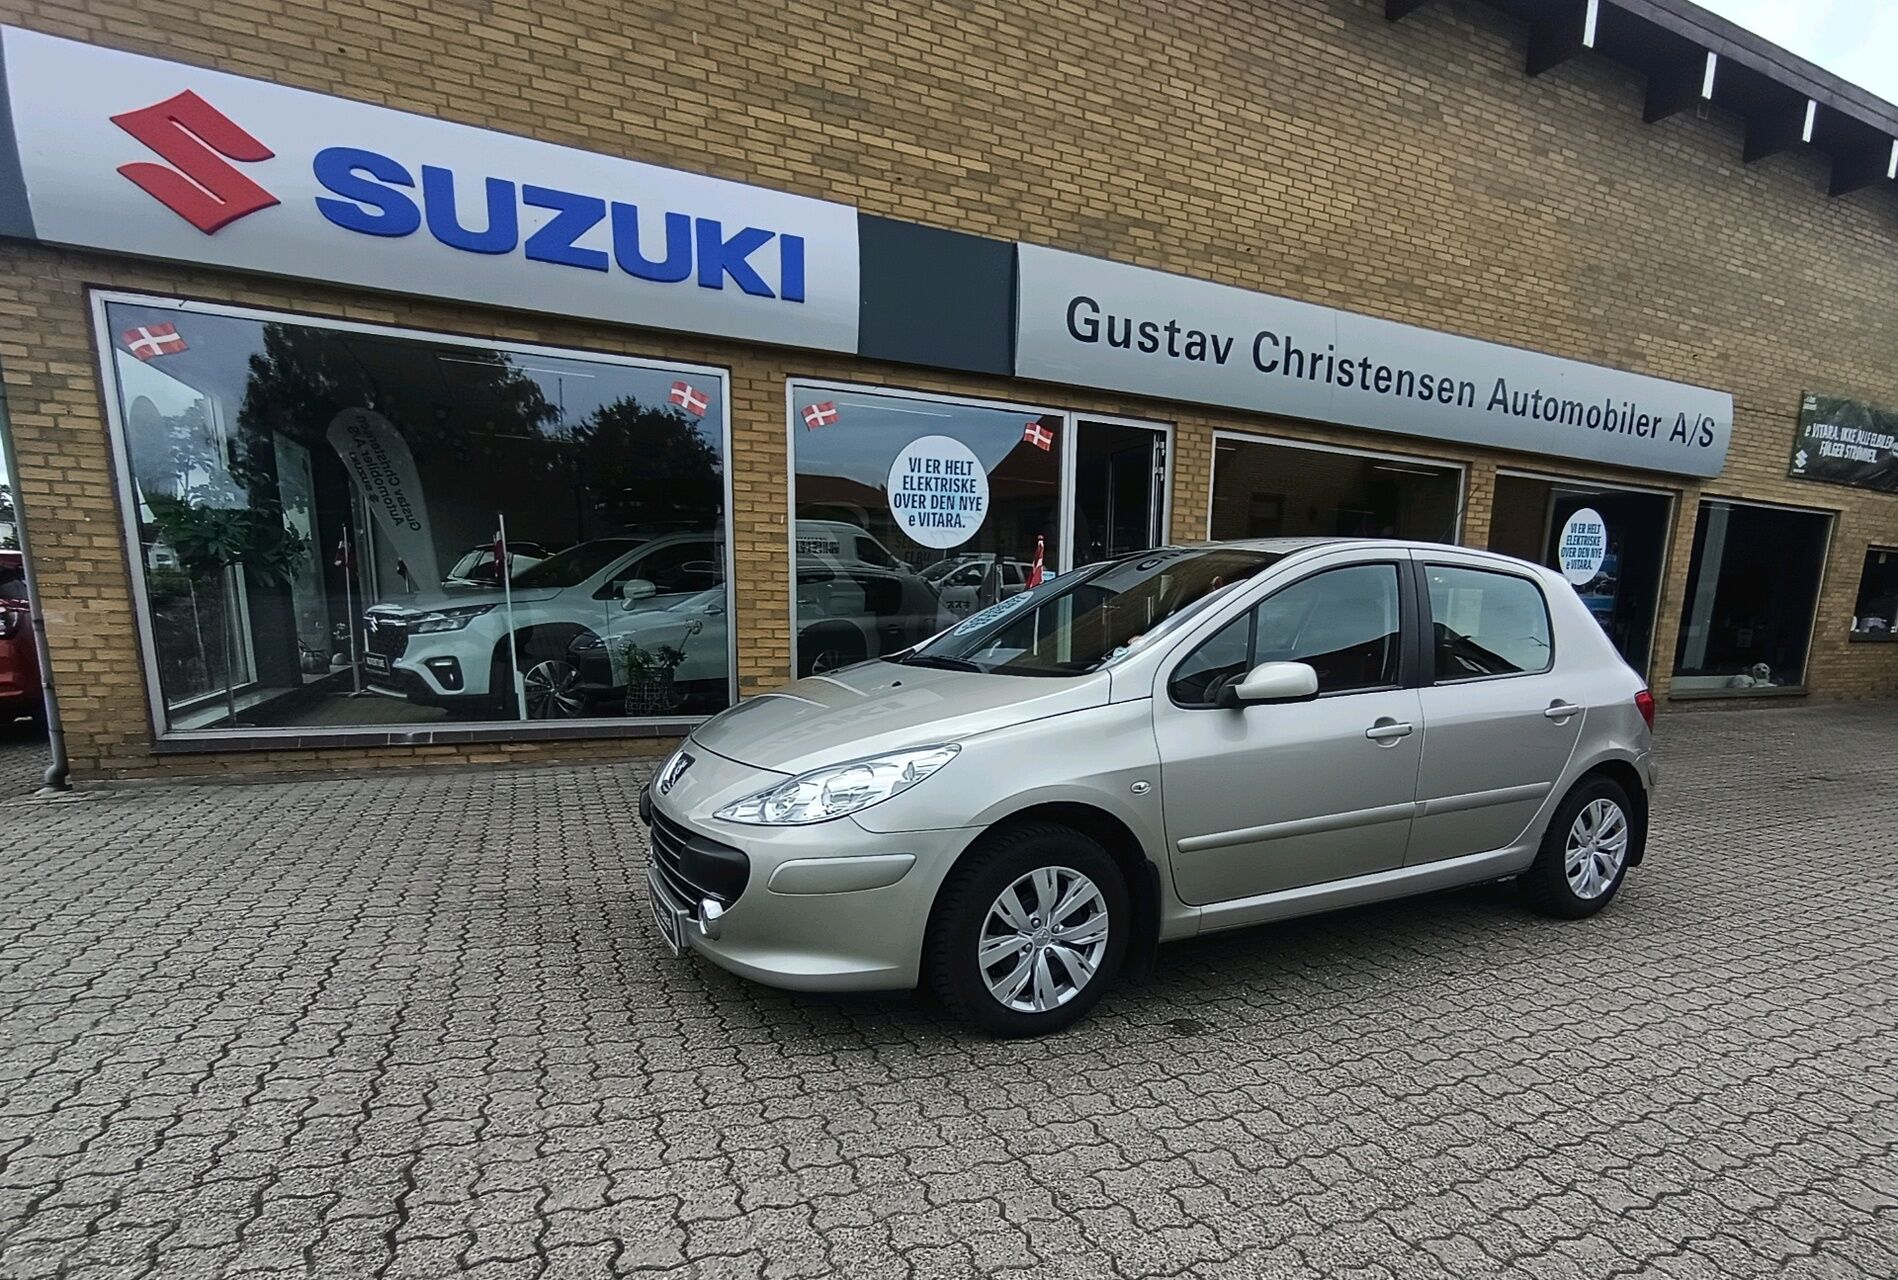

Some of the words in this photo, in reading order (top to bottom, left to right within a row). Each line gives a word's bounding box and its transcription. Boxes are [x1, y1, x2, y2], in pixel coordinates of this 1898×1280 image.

[313, 146, 805, 303] SUZUKI
[1066, 295, 1234, 365] Gustav
[1252, 330, 1475, 407] Christensen
[1487, 377, 1662, 439] Automobiler
[1669, 412, 1715, 448] A/S
[908, 457, 921, 473] VI
[925, 459, 941, 474] ER
[945, 460, 974, 476] HELT
[902, 475, 977, 494] ELEKTRISKE
[894, 493, 926, 509] OVER
[930, 495, 955, 511] DEN
[959, 496, 983, 512] NYE
[908, 515, 916, 527] e
[918, 512, 966, 529] VITARA.
[1571, 523, 1577, 533] VI
[1578, 523, 1586, 534] ER
[1587, 523, 1602, 534] HELT
[1566, 535, 1601, 545] ELEKTRISKE
[1561, 546, 1577, 558] OVER
[1577, 547, 1590, 558] DEN
[1591, 548, 1602, 558] NYE
[1566, 561, 1570, 569] e
[1571, 559, 1593, 569] VITARA.
